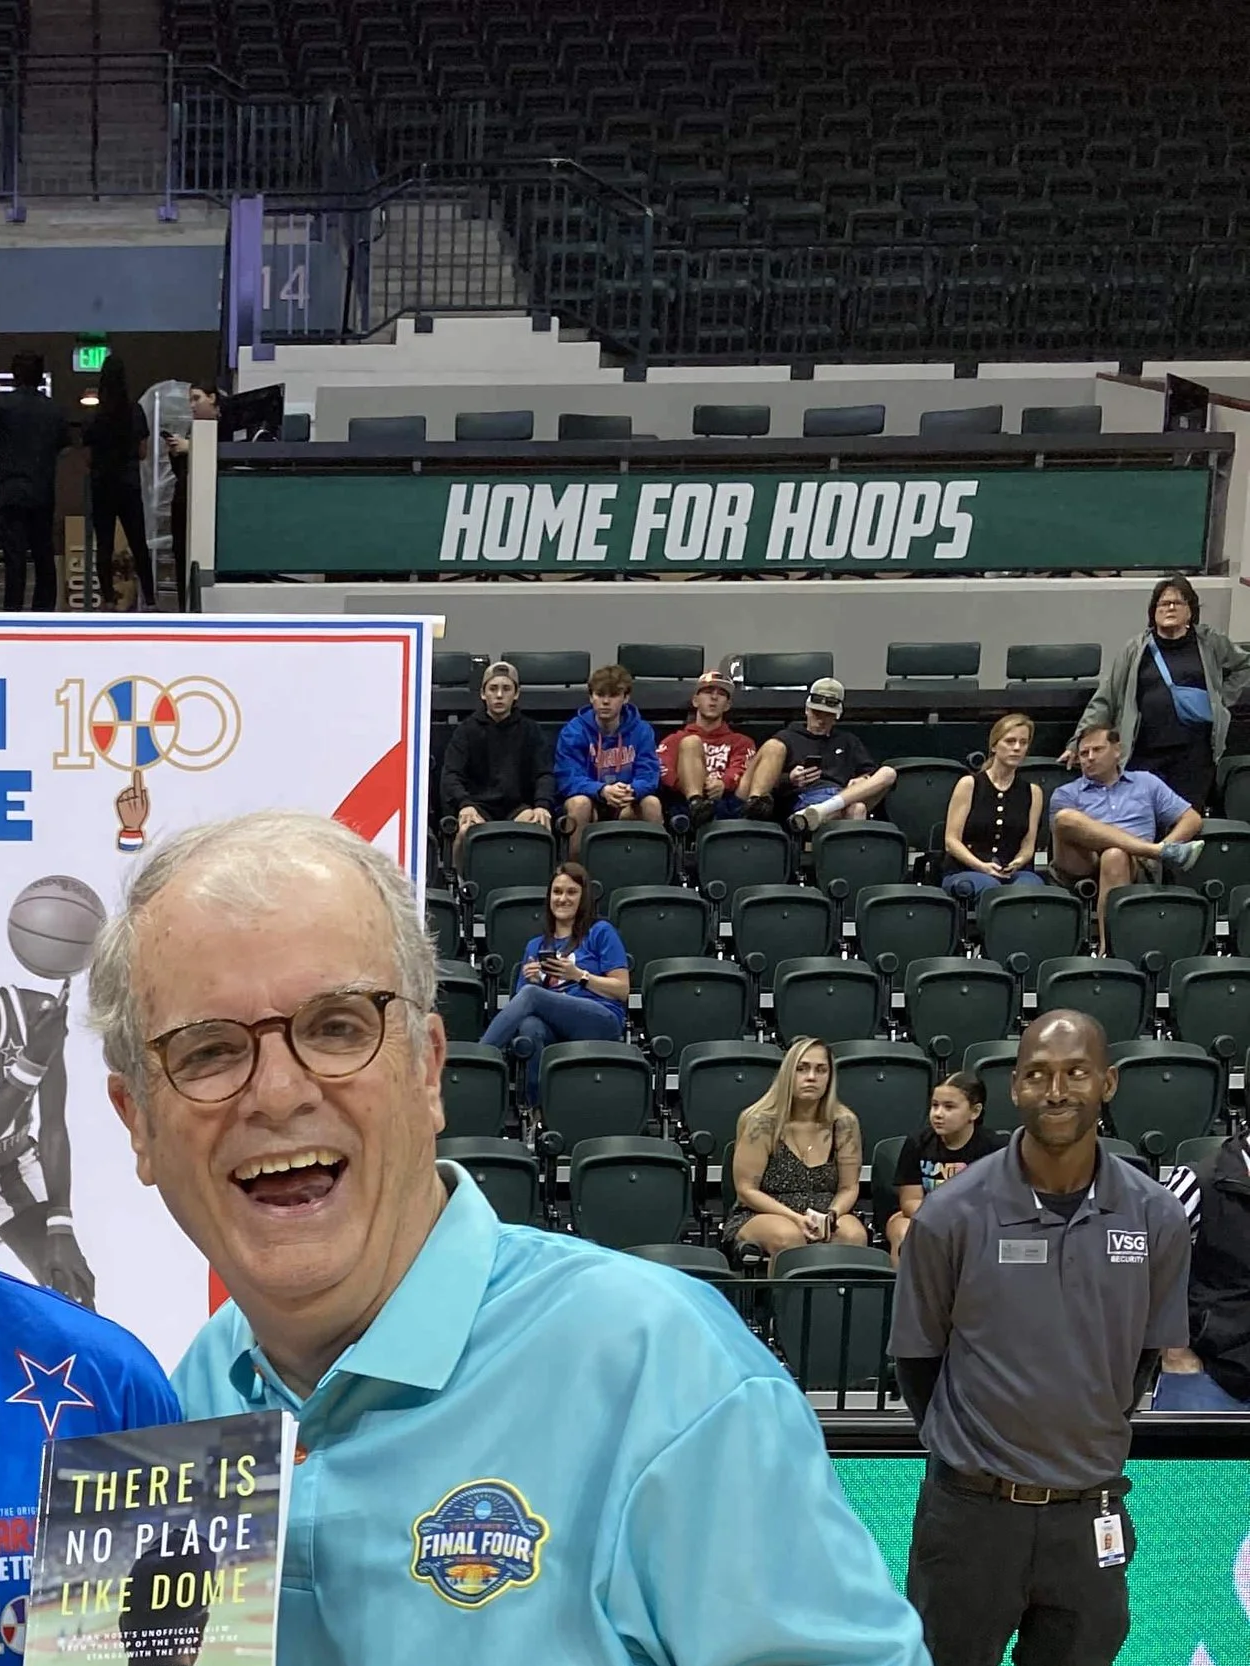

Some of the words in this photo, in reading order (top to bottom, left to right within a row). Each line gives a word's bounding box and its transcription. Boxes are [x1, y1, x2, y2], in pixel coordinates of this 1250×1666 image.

[439, 483, 618, 561] HOME
[629, 482, 755, 561] FOR
[765, 480, 979, 560] HOOPS
[1112, 1234, 1145, 1250] VSG
[1111, 1255, 1145, 1263] SECURITY
[72, 1462, 195, 1514] THERE
[218, 1455, 256, 1499] IS
[0, 1507, 15, 1517] THE
[66, 1528, 112, 1565] NO
[135, 1513, 252, 1560] PLACE
[421, 1531, 477, 1559] FINAL
[481, 1531, 531, 1562] FOUR
[61, 1577, 134, 1616] LIKE
[151, 1567, 248, 1610] DOME
[141, 1626, 200, 1638] UNOFFICIAL
[135, 1640, 148, 1649] OF
[151, 1638, 169, 1647] THE
[173, 1636, 199, 1646] TROP
[126, 1649, 151, 1659] WITH
[156, 1648, 174, 1657] THE
